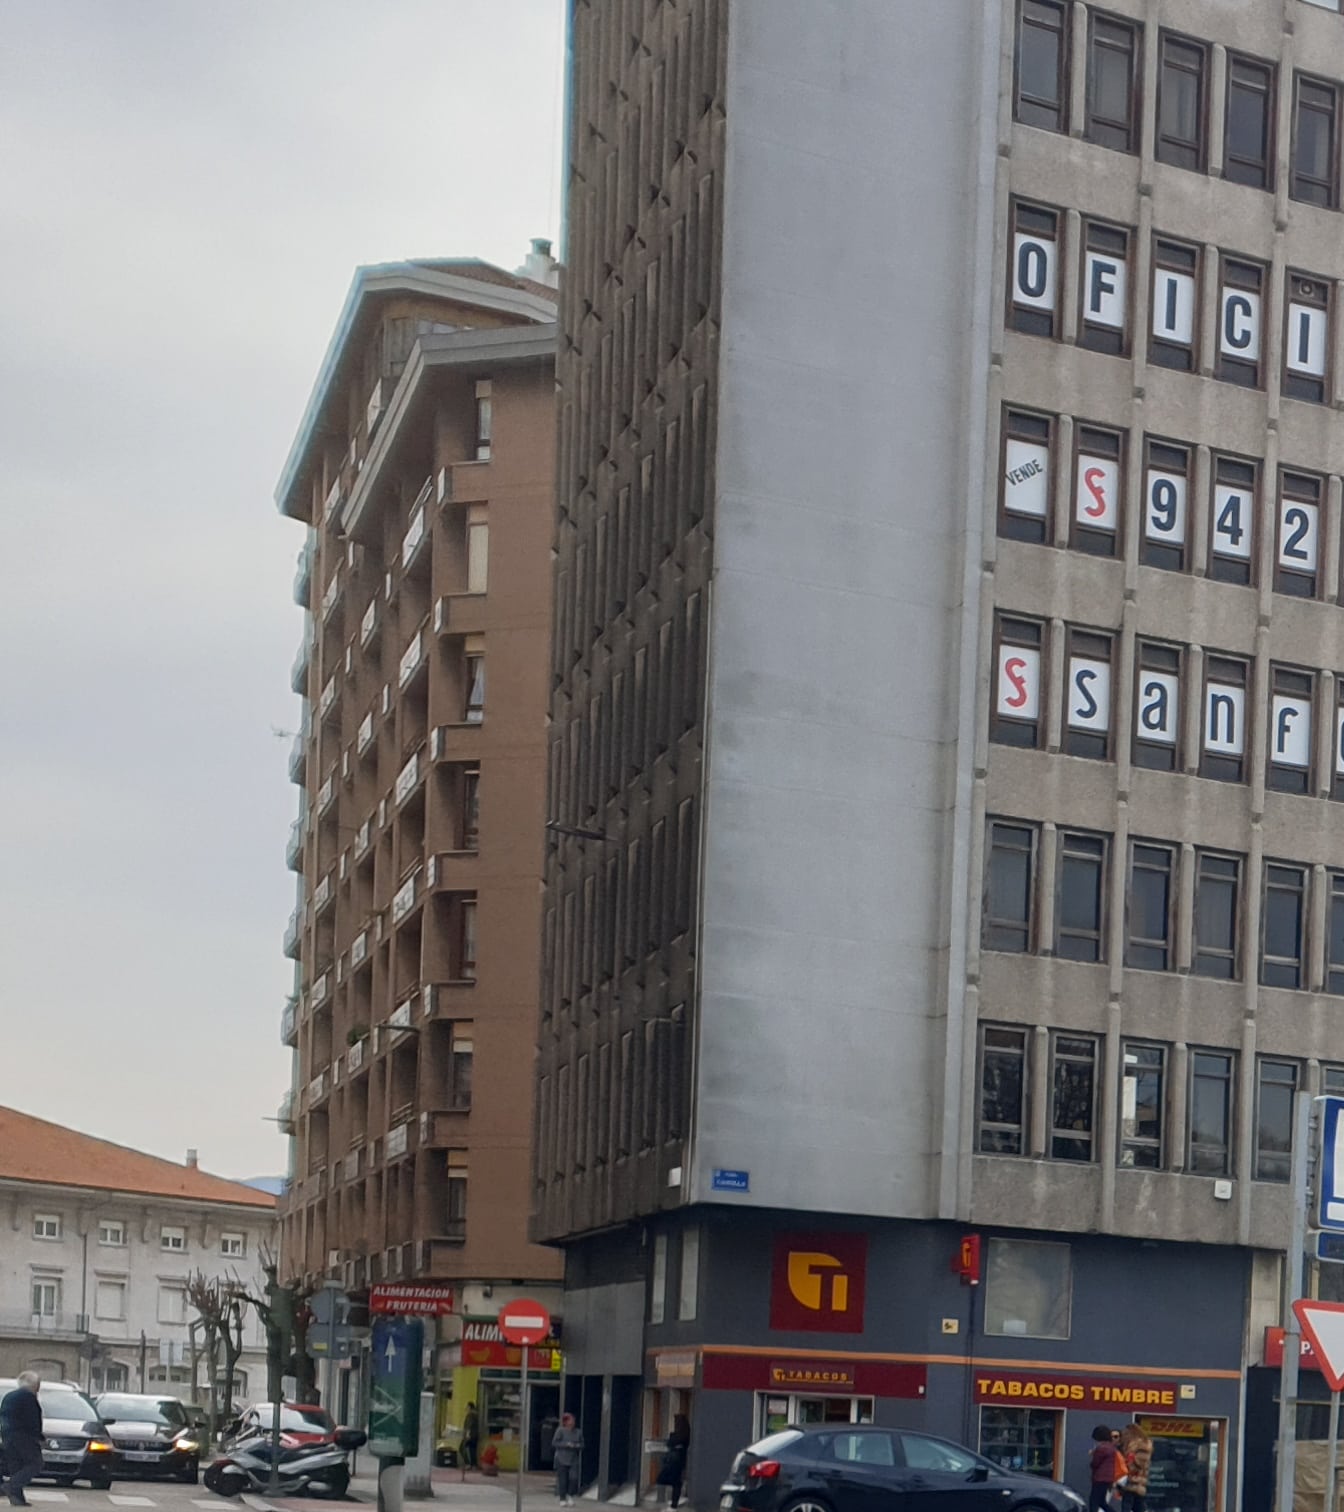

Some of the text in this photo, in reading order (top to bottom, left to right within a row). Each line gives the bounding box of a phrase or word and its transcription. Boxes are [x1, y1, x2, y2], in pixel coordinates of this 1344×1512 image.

[1005, 459, 1043, 486] VENDE
[373, 1286, 450, 1299] ALIMENTACION
[977, 1379, 1175, 1405] TABACOS TIMBRE
[1150, 1422, 1195, 1433] DHL
